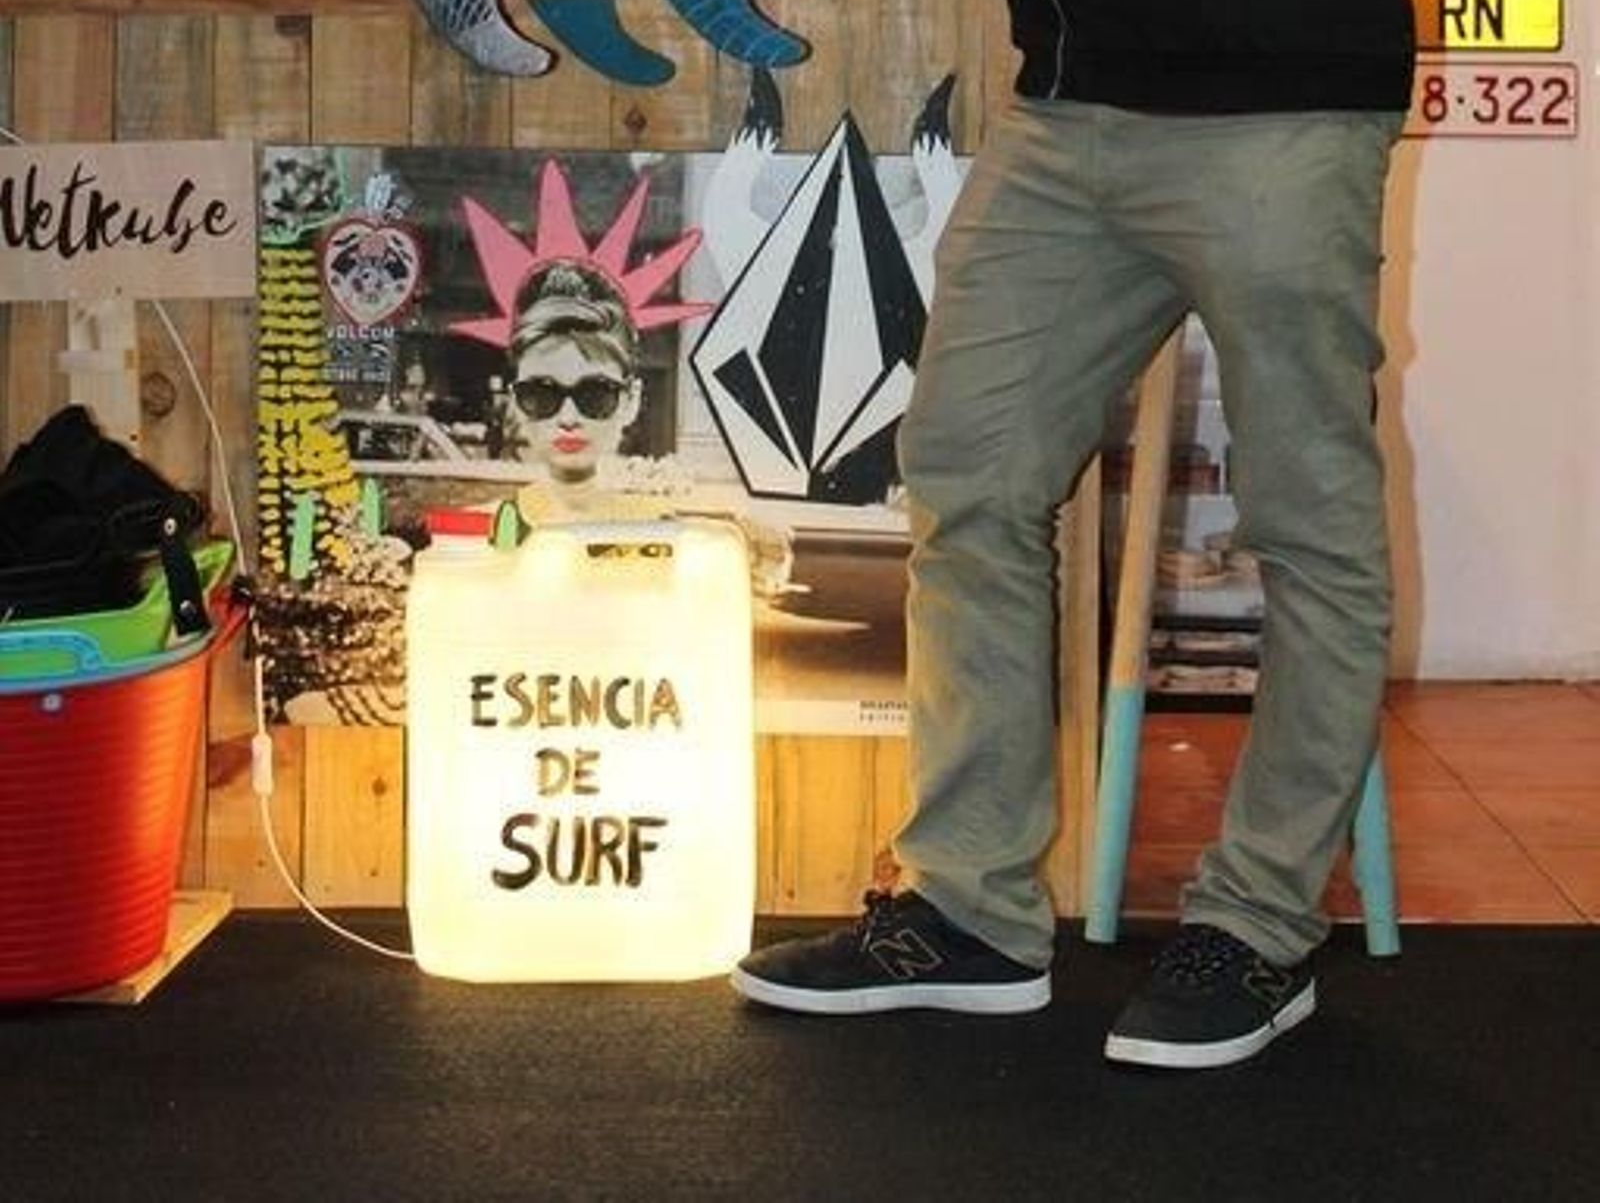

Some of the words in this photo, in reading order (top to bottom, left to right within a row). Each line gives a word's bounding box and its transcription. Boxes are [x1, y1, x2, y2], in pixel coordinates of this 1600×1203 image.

[470, 672, 684, 732] ESENCIA
[534, 747, 600, 796] DE
[491, 812, 668, 891] SURF
